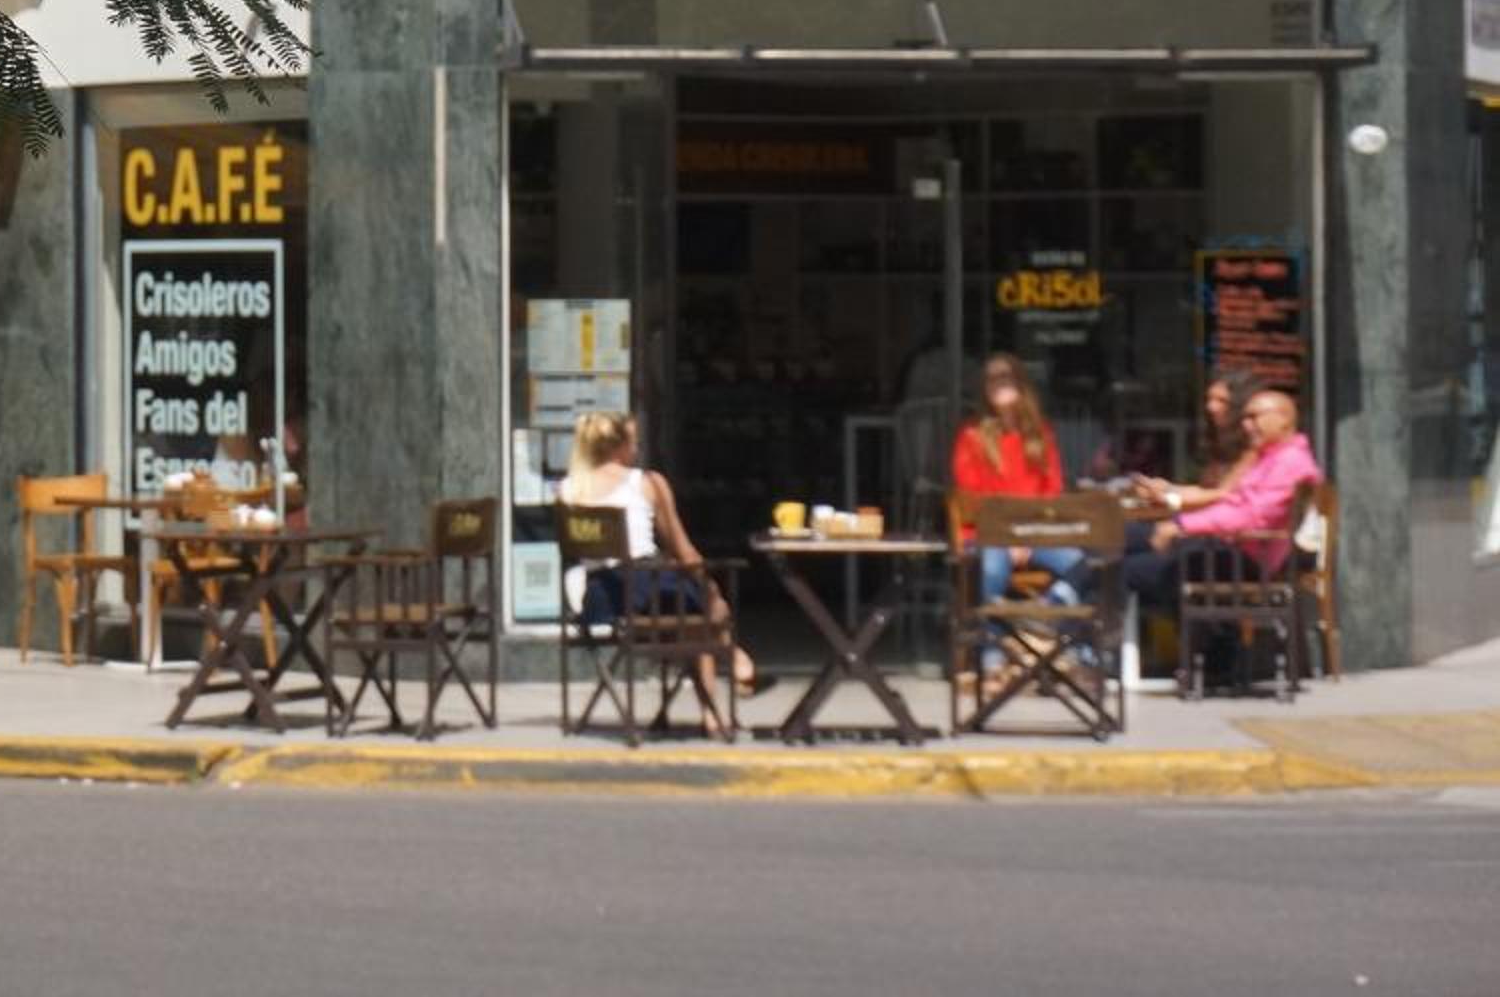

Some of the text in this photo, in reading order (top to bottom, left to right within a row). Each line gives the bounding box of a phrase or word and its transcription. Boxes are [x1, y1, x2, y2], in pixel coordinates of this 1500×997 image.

[135, 270, 270, 318] Crisoleros
[135, 331, 236, 385] Amigos
[135, 389, 247, 436] Fans del
